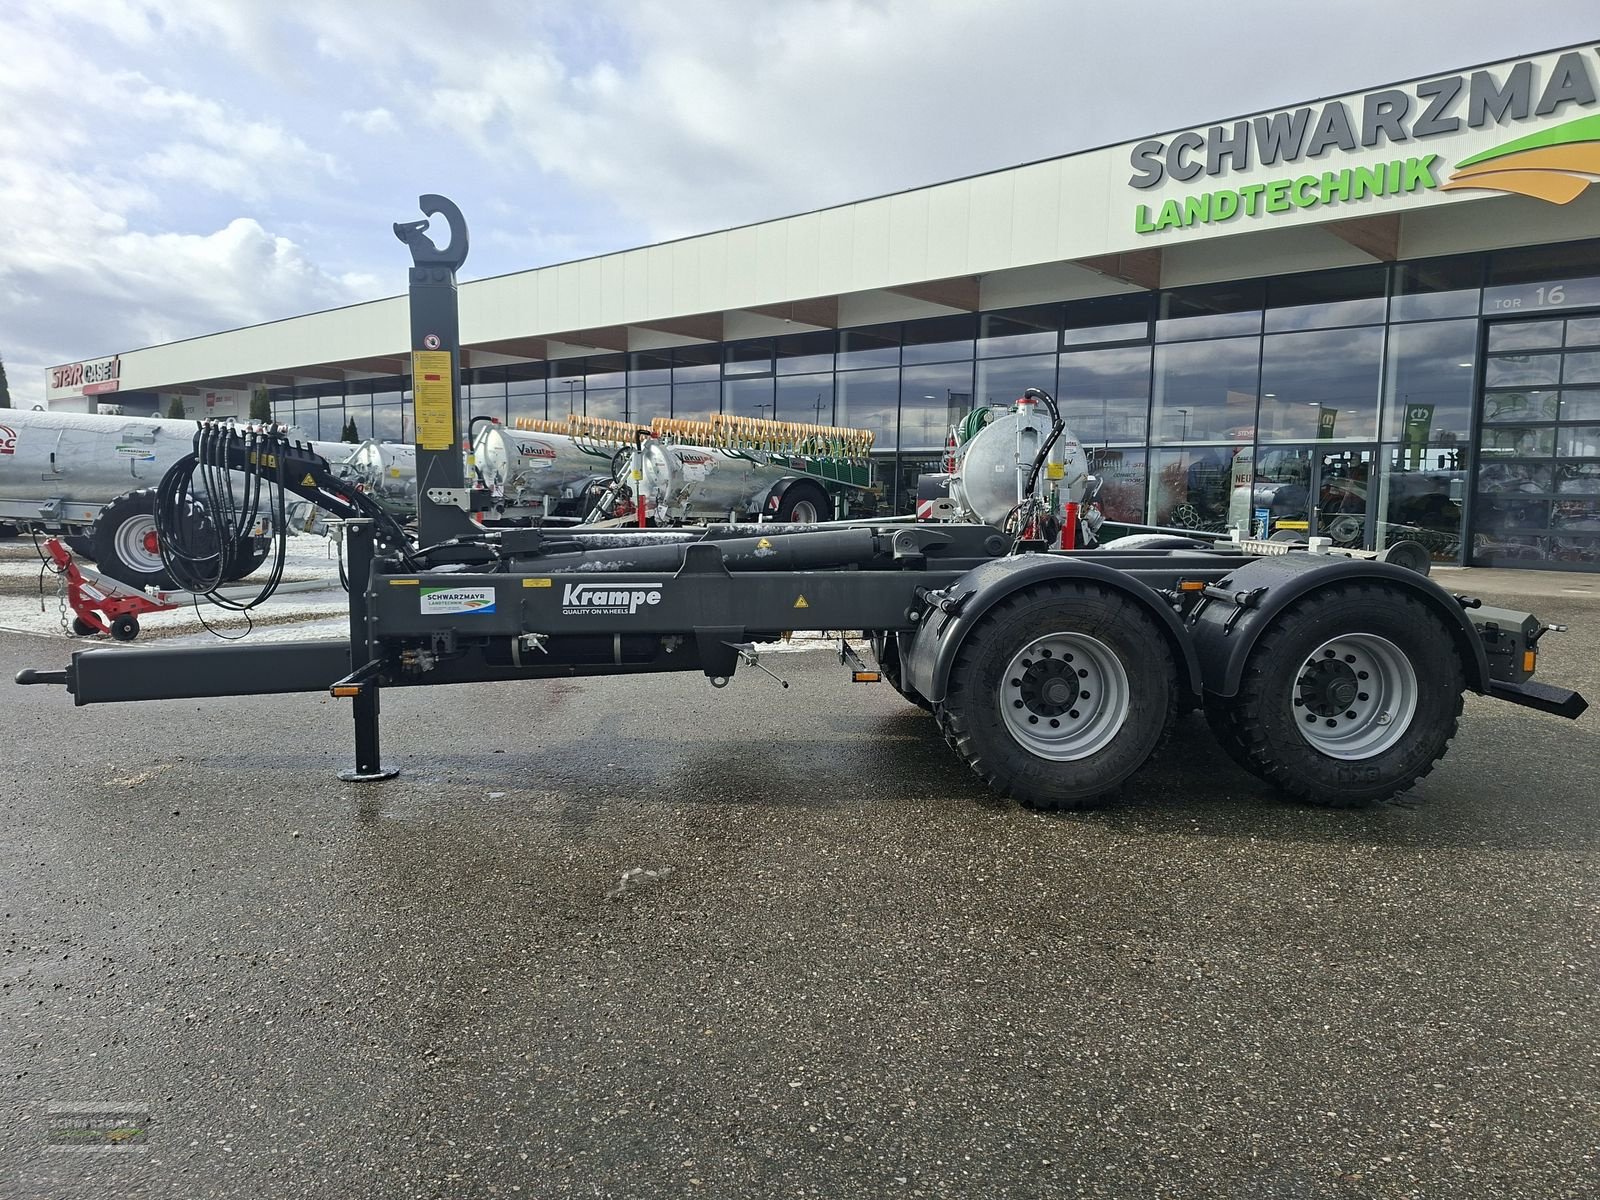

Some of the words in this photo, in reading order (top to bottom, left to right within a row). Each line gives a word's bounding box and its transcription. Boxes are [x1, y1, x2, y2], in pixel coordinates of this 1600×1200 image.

[1128, 48, 1600, 189] SCHWARZMA
[1135, 154, 1438, 234] LANDTECHNIK
[1495, 299, 1521, 309] TOR
[1536, 286, 1565, 305] 16
[52, 363, 83, 388] STEYR
[1235, 474, 1252, 483] NEU
[427, 593, 485, 601] SCHWARZMAYR
[562, 583, 662, 614] Krampe
